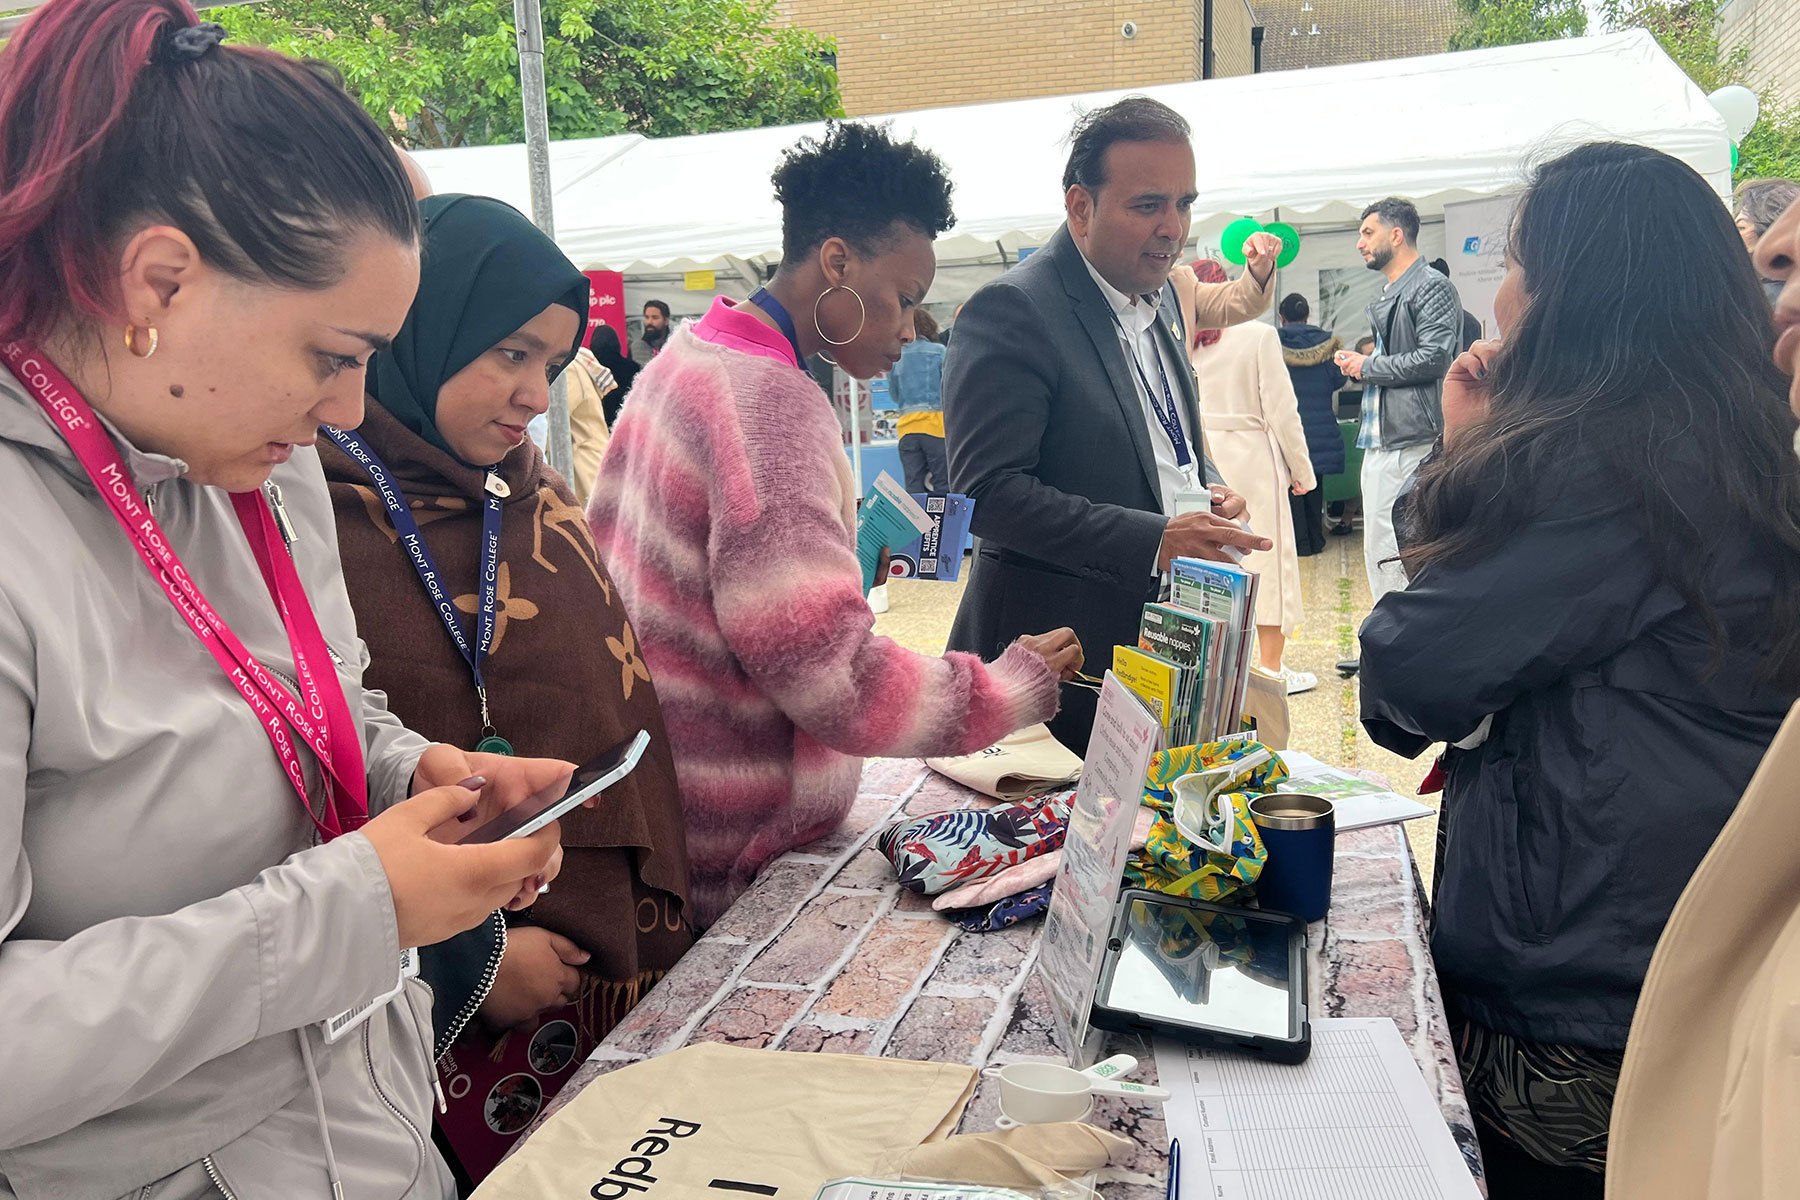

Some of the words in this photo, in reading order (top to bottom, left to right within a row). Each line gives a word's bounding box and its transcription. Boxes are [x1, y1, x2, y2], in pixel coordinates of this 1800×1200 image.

[599, 294, 616, 307] plc
[21, 358, 85, 430] COLLEGE
[347, 440, 372, 464] ROSE
[369, 463, 401, 511] COLLEGE
[101, 462, 143, 517] MONT
[140, 519, 173, 564] ROSE
[173, 565, 224, 631] COLLEGE
[485, 533, 498, 583] COLLEGE
[929, 514, 941, 557] APPRENTICE
[160, 569, 212, 638] COLLEGE
[405, 533, 429, 569] MONT
[423, 571, 444, 601] ROSE
[439, 601, 468, 650] COLLEGE
[483, 584, 495, 614] ROSE
[480, 614, 493, 652] MONT
[1144, 627, 1168, 644] Reusable
[1169, 637, 1191, 652] nappies
[297, 651, 324, 720] COLLEGE
[1116, 656, 1127, 667] Hello
[232, 667, 270, 714] MONT
[269, 716, 292, 759] ROSE
[246, 658, 284, 702] MONT
[286, 701, 314, 739] ROSE
[1201, 1113, 1209, 1128] Contact
[1209, 1153, 1217, 1163] Email
